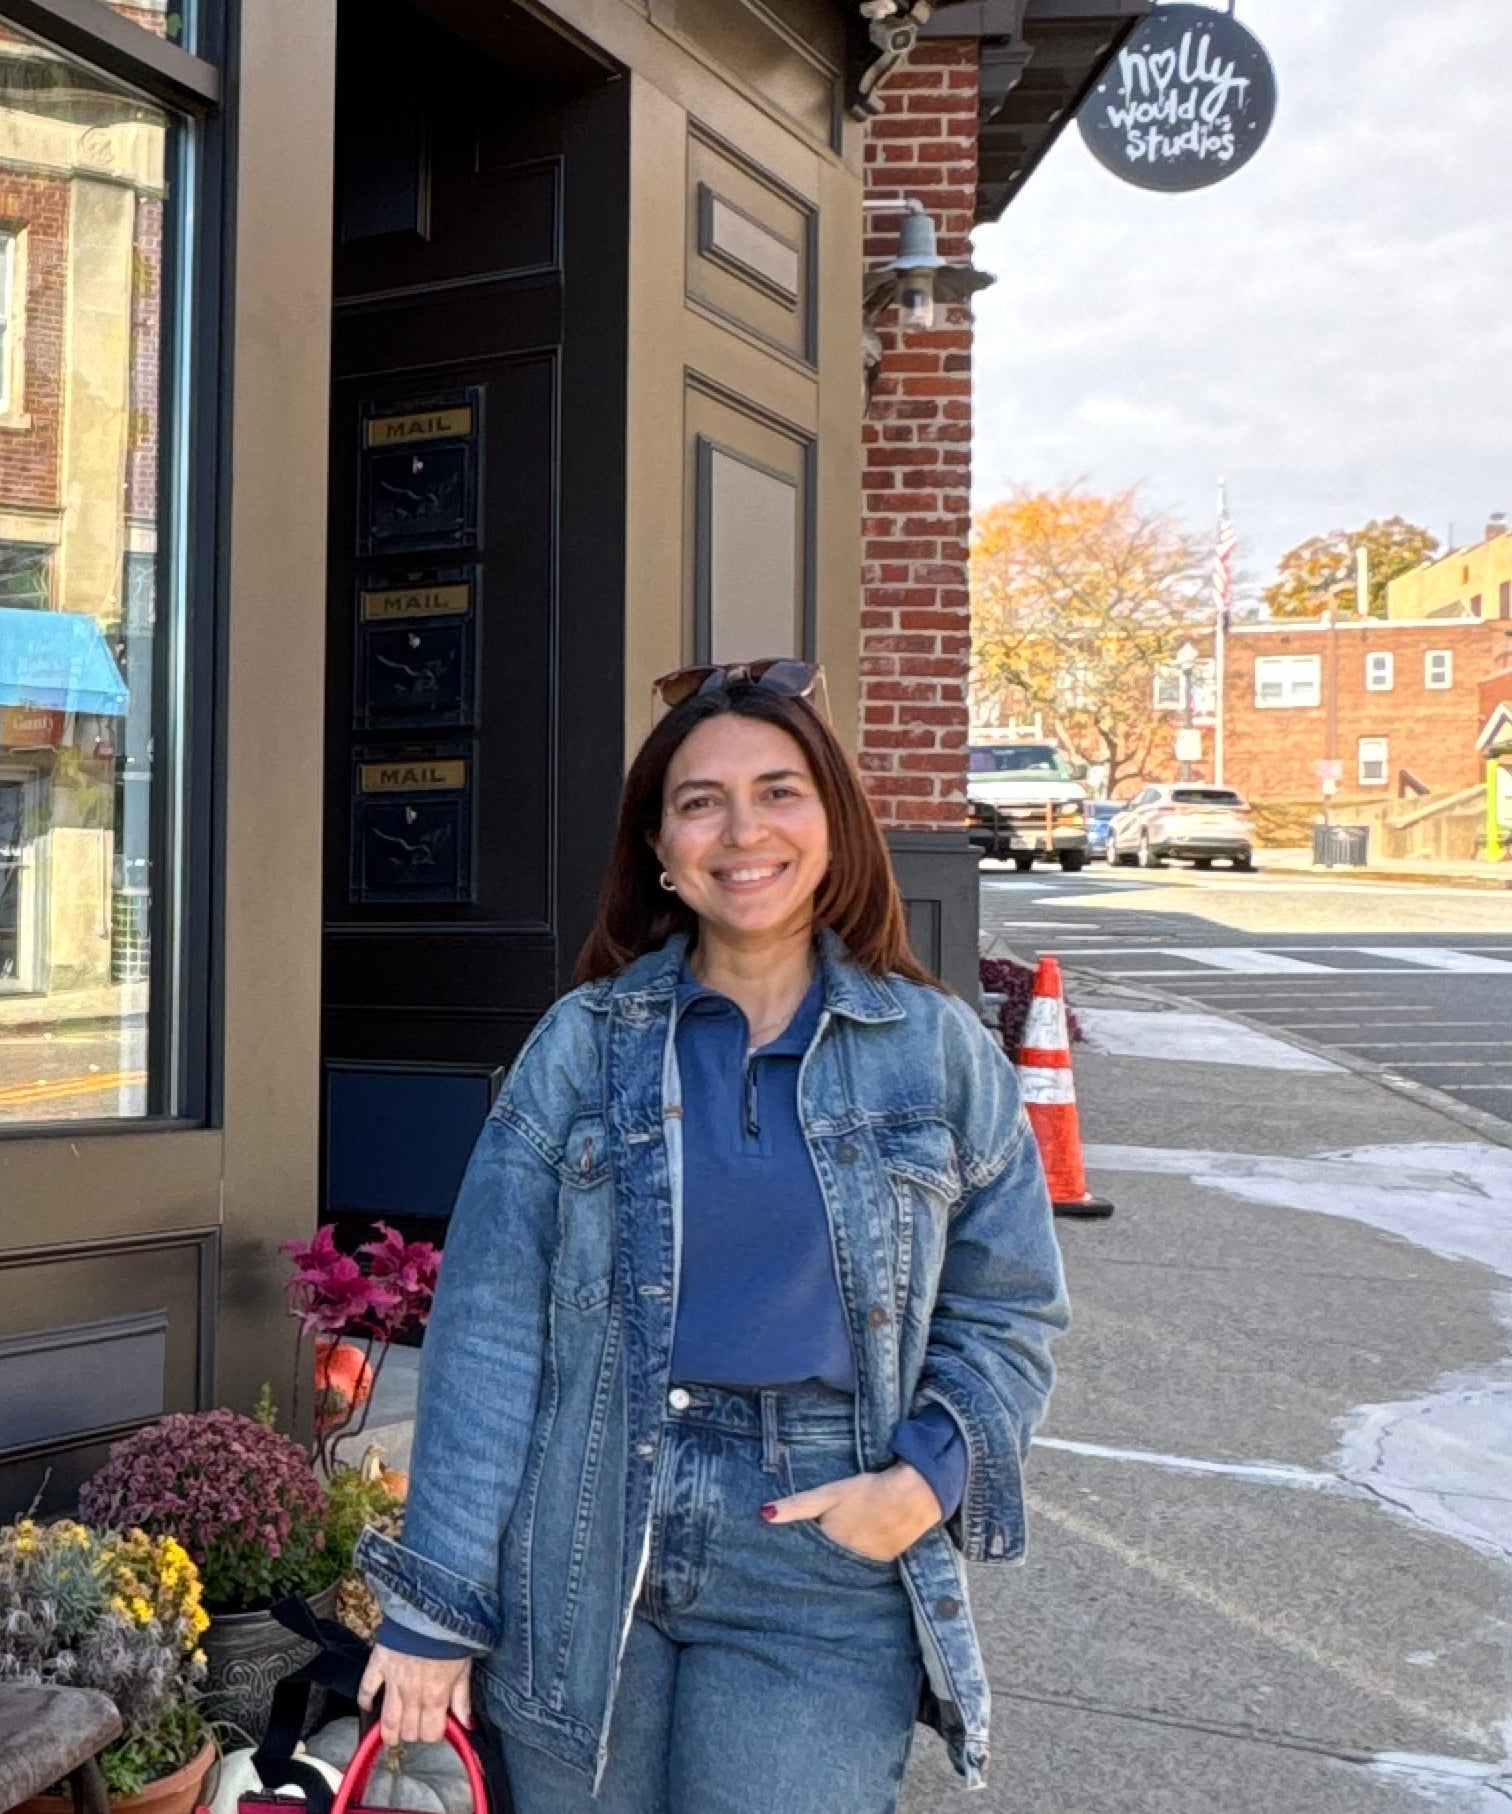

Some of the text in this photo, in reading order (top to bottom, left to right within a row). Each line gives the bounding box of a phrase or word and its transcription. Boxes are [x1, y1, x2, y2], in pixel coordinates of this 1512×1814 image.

[387, 416, 452, 438] MAIL
[384, 594, 449, 613] MAIL
[380, 768, 447, 785] MAIL
